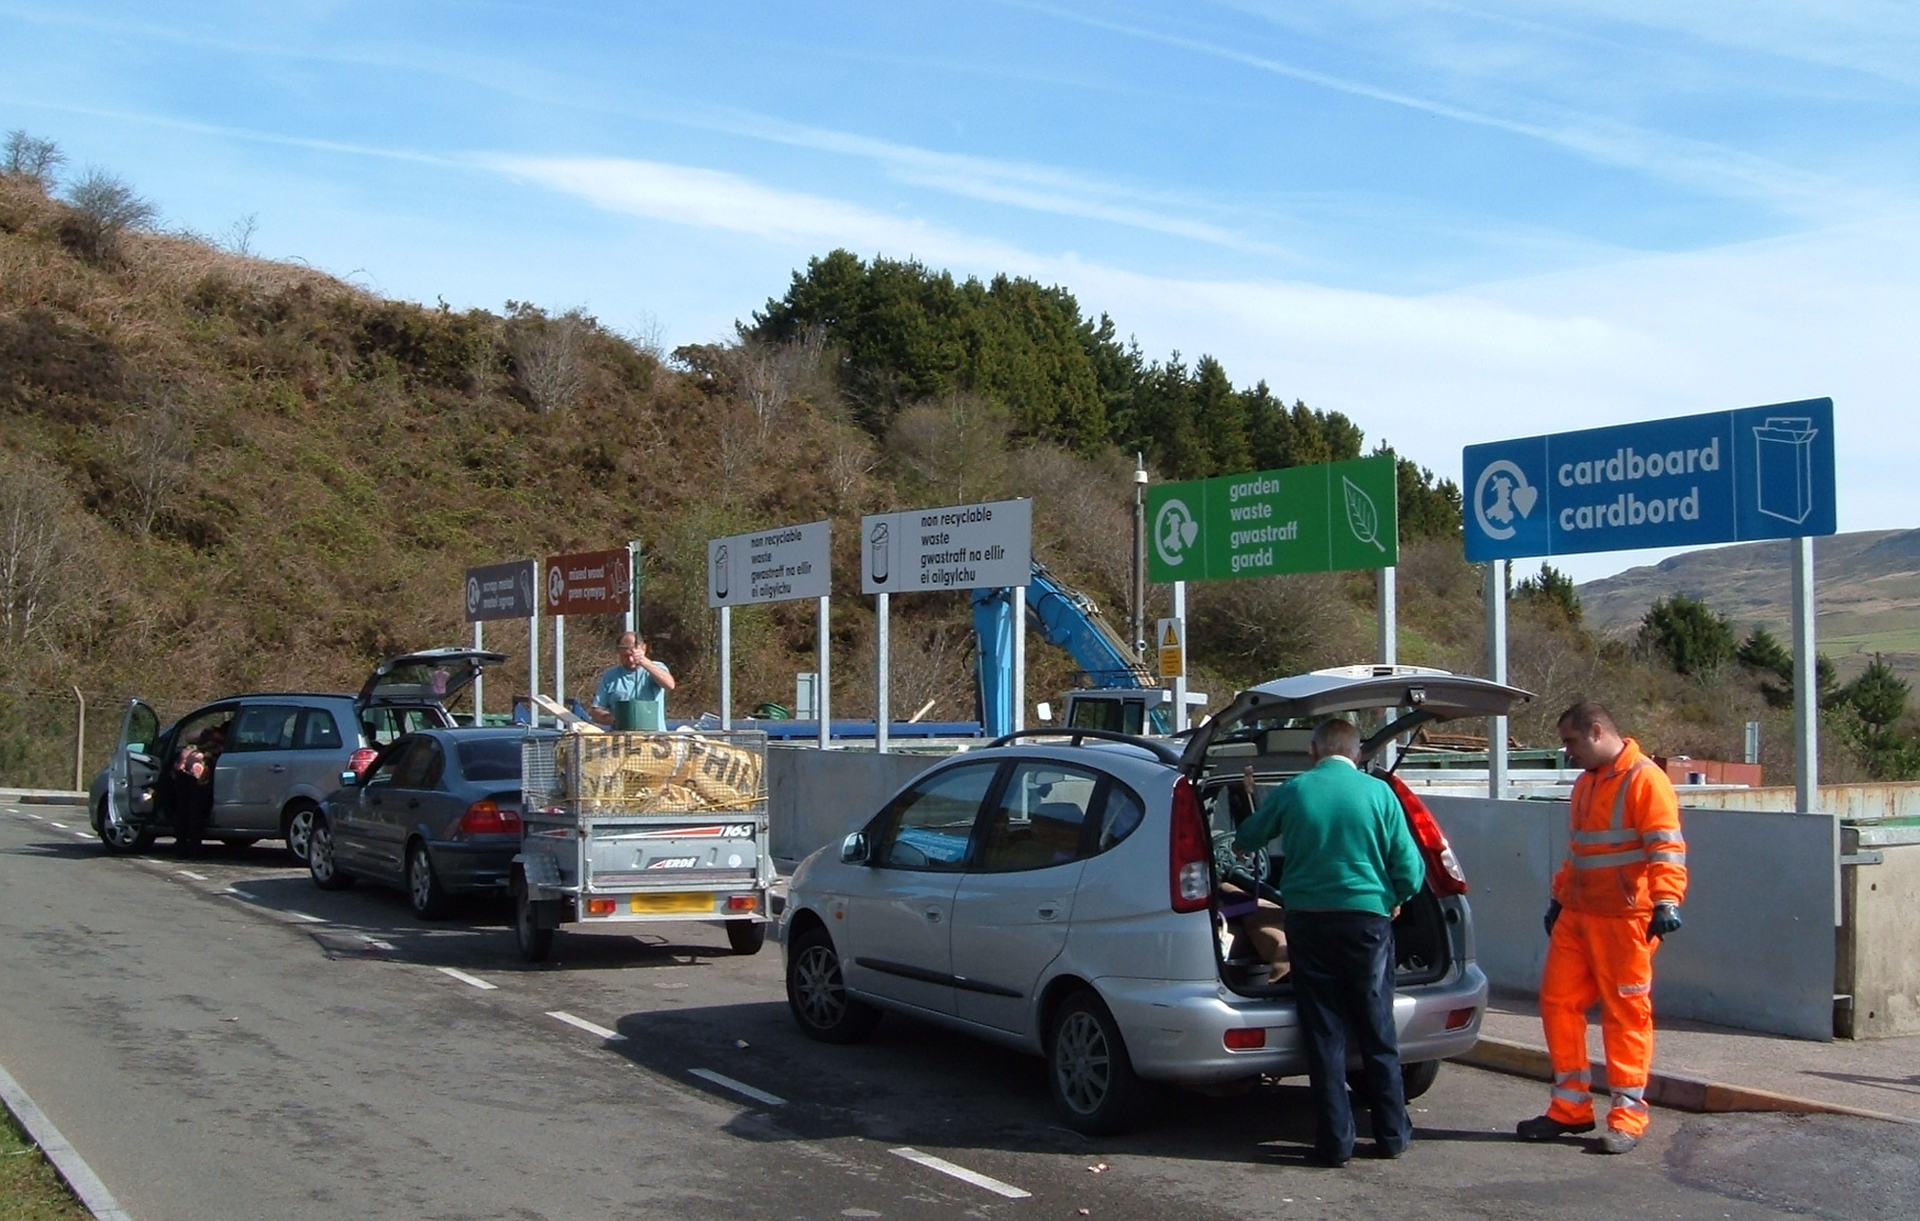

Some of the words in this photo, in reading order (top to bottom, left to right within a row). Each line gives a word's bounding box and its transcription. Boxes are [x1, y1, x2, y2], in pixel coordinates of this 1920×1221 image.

[1558, 437, 1720, 487] cardboard
[1229, 476, 1280, 502] garden
[921, 515, 939, 527] non
[941, 507, 992, 527] recyclable
[1230, 502, 1272, 521] waste
[1559, 486, 1699, 531] cardbord
[750, 538, 764, 548] non
[765, 529, 803, 547] recyclable
[921, 532, 950, 546] waste
[1230, 521, 1298, 549] gwastraff
[751, 551, 772, 564] waste
[920, 548, 967, 569] gwastraff
[984, 545, 1005, 561] ellir
[1231, 547, 1273, 573] gardd
[920, 570, 930, 584] ei
[932, 567, 976, 586] ailgylchu
[722, 825, 753, 838] 163
